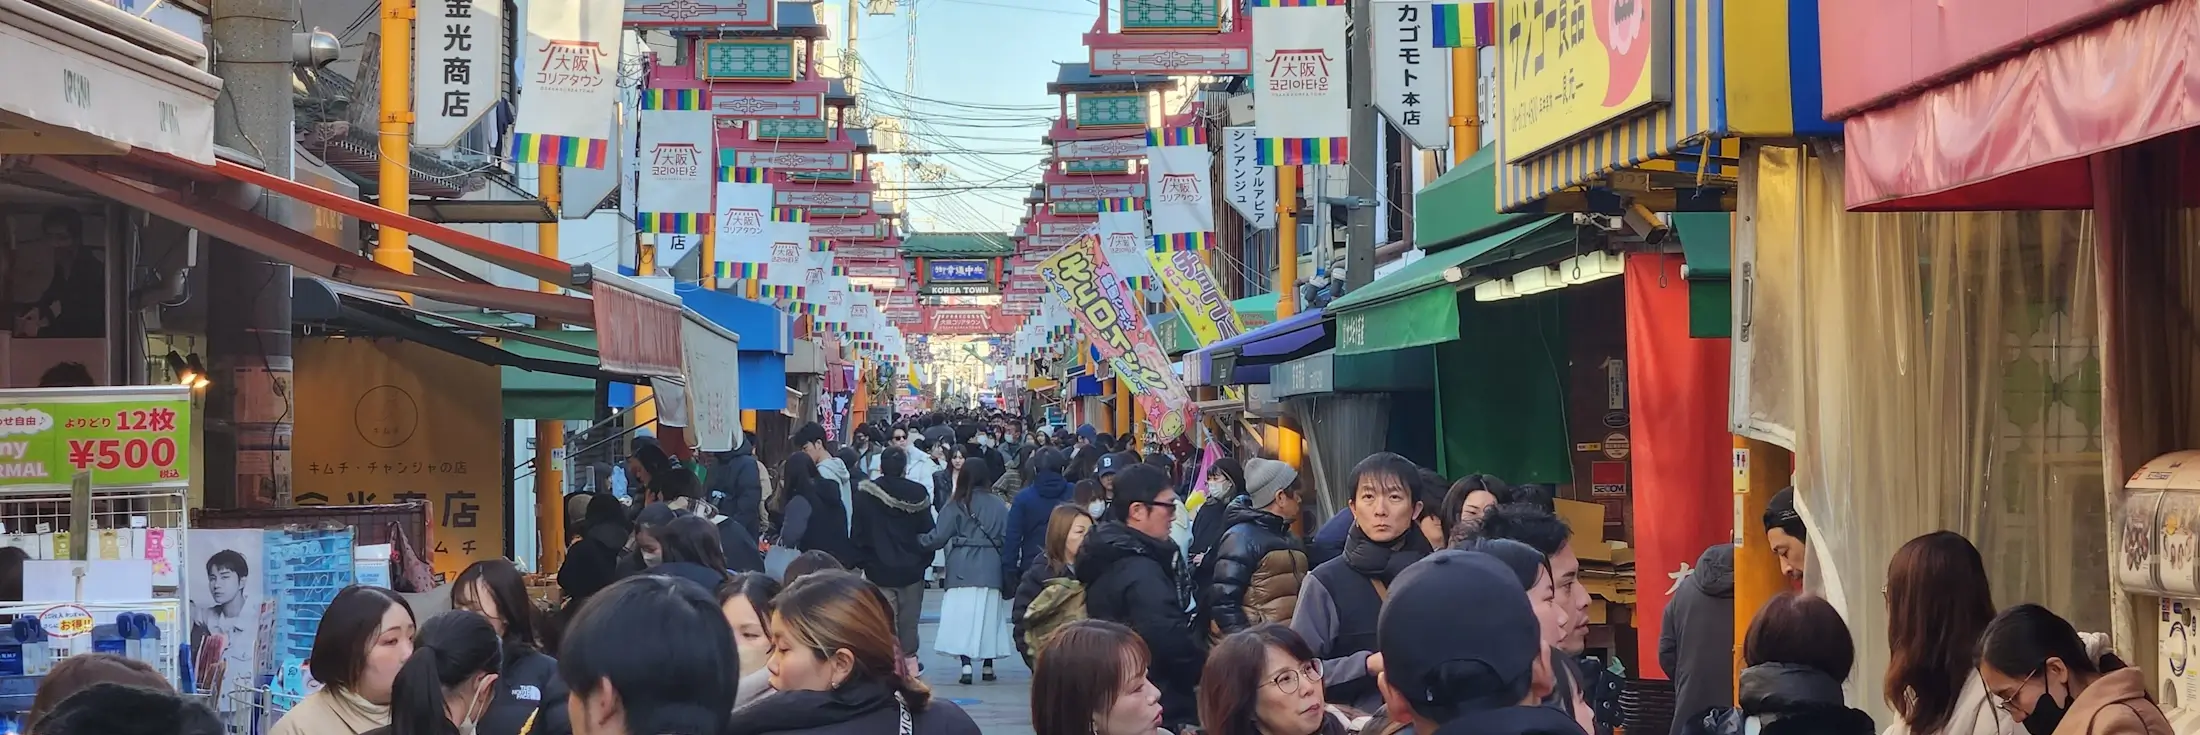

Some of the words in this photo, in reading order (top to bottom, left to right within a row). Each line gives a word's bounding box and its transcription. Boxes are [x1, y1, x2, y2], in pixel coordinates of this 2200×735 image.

[442, 0, 472, 117] 金光商店
[553, 54, 590, 72] 大阪
[1398, 4, 1421, 125] カゴモト本店
[1282, 62, 1316, 78] 大阪
[536, 72, 603, 87] コリアタウン
[1269, 77, 1329, 91] 코리아타운
[662, 153, 688, 166] 大阪
[1234, 130, 1247, 203] シンアンジュ
[652, 165, 697, 176] 코리아타운
[1170, 182, 1190, 193] 大阪
[733, 216, 754, 226] 大阪
[723, 226, 763, 234] コリアタウン
[963, 286, 989, 294] TOWN
[0, 416, 36, 426] せ自由
[65, 418, 111, 428] よりどり
[117, 408, 175, 432] 12枚
[68, 437, 175, 469] ¥500
[309, 461, 468, 475] キムチ・チャンジャの店
[1103, 457, 1112, 467] B
[160, 469, 180, 478] 税込
[1594, 485, 1624, 493] SECOM
[434, 540, 477, 555] ムチ
